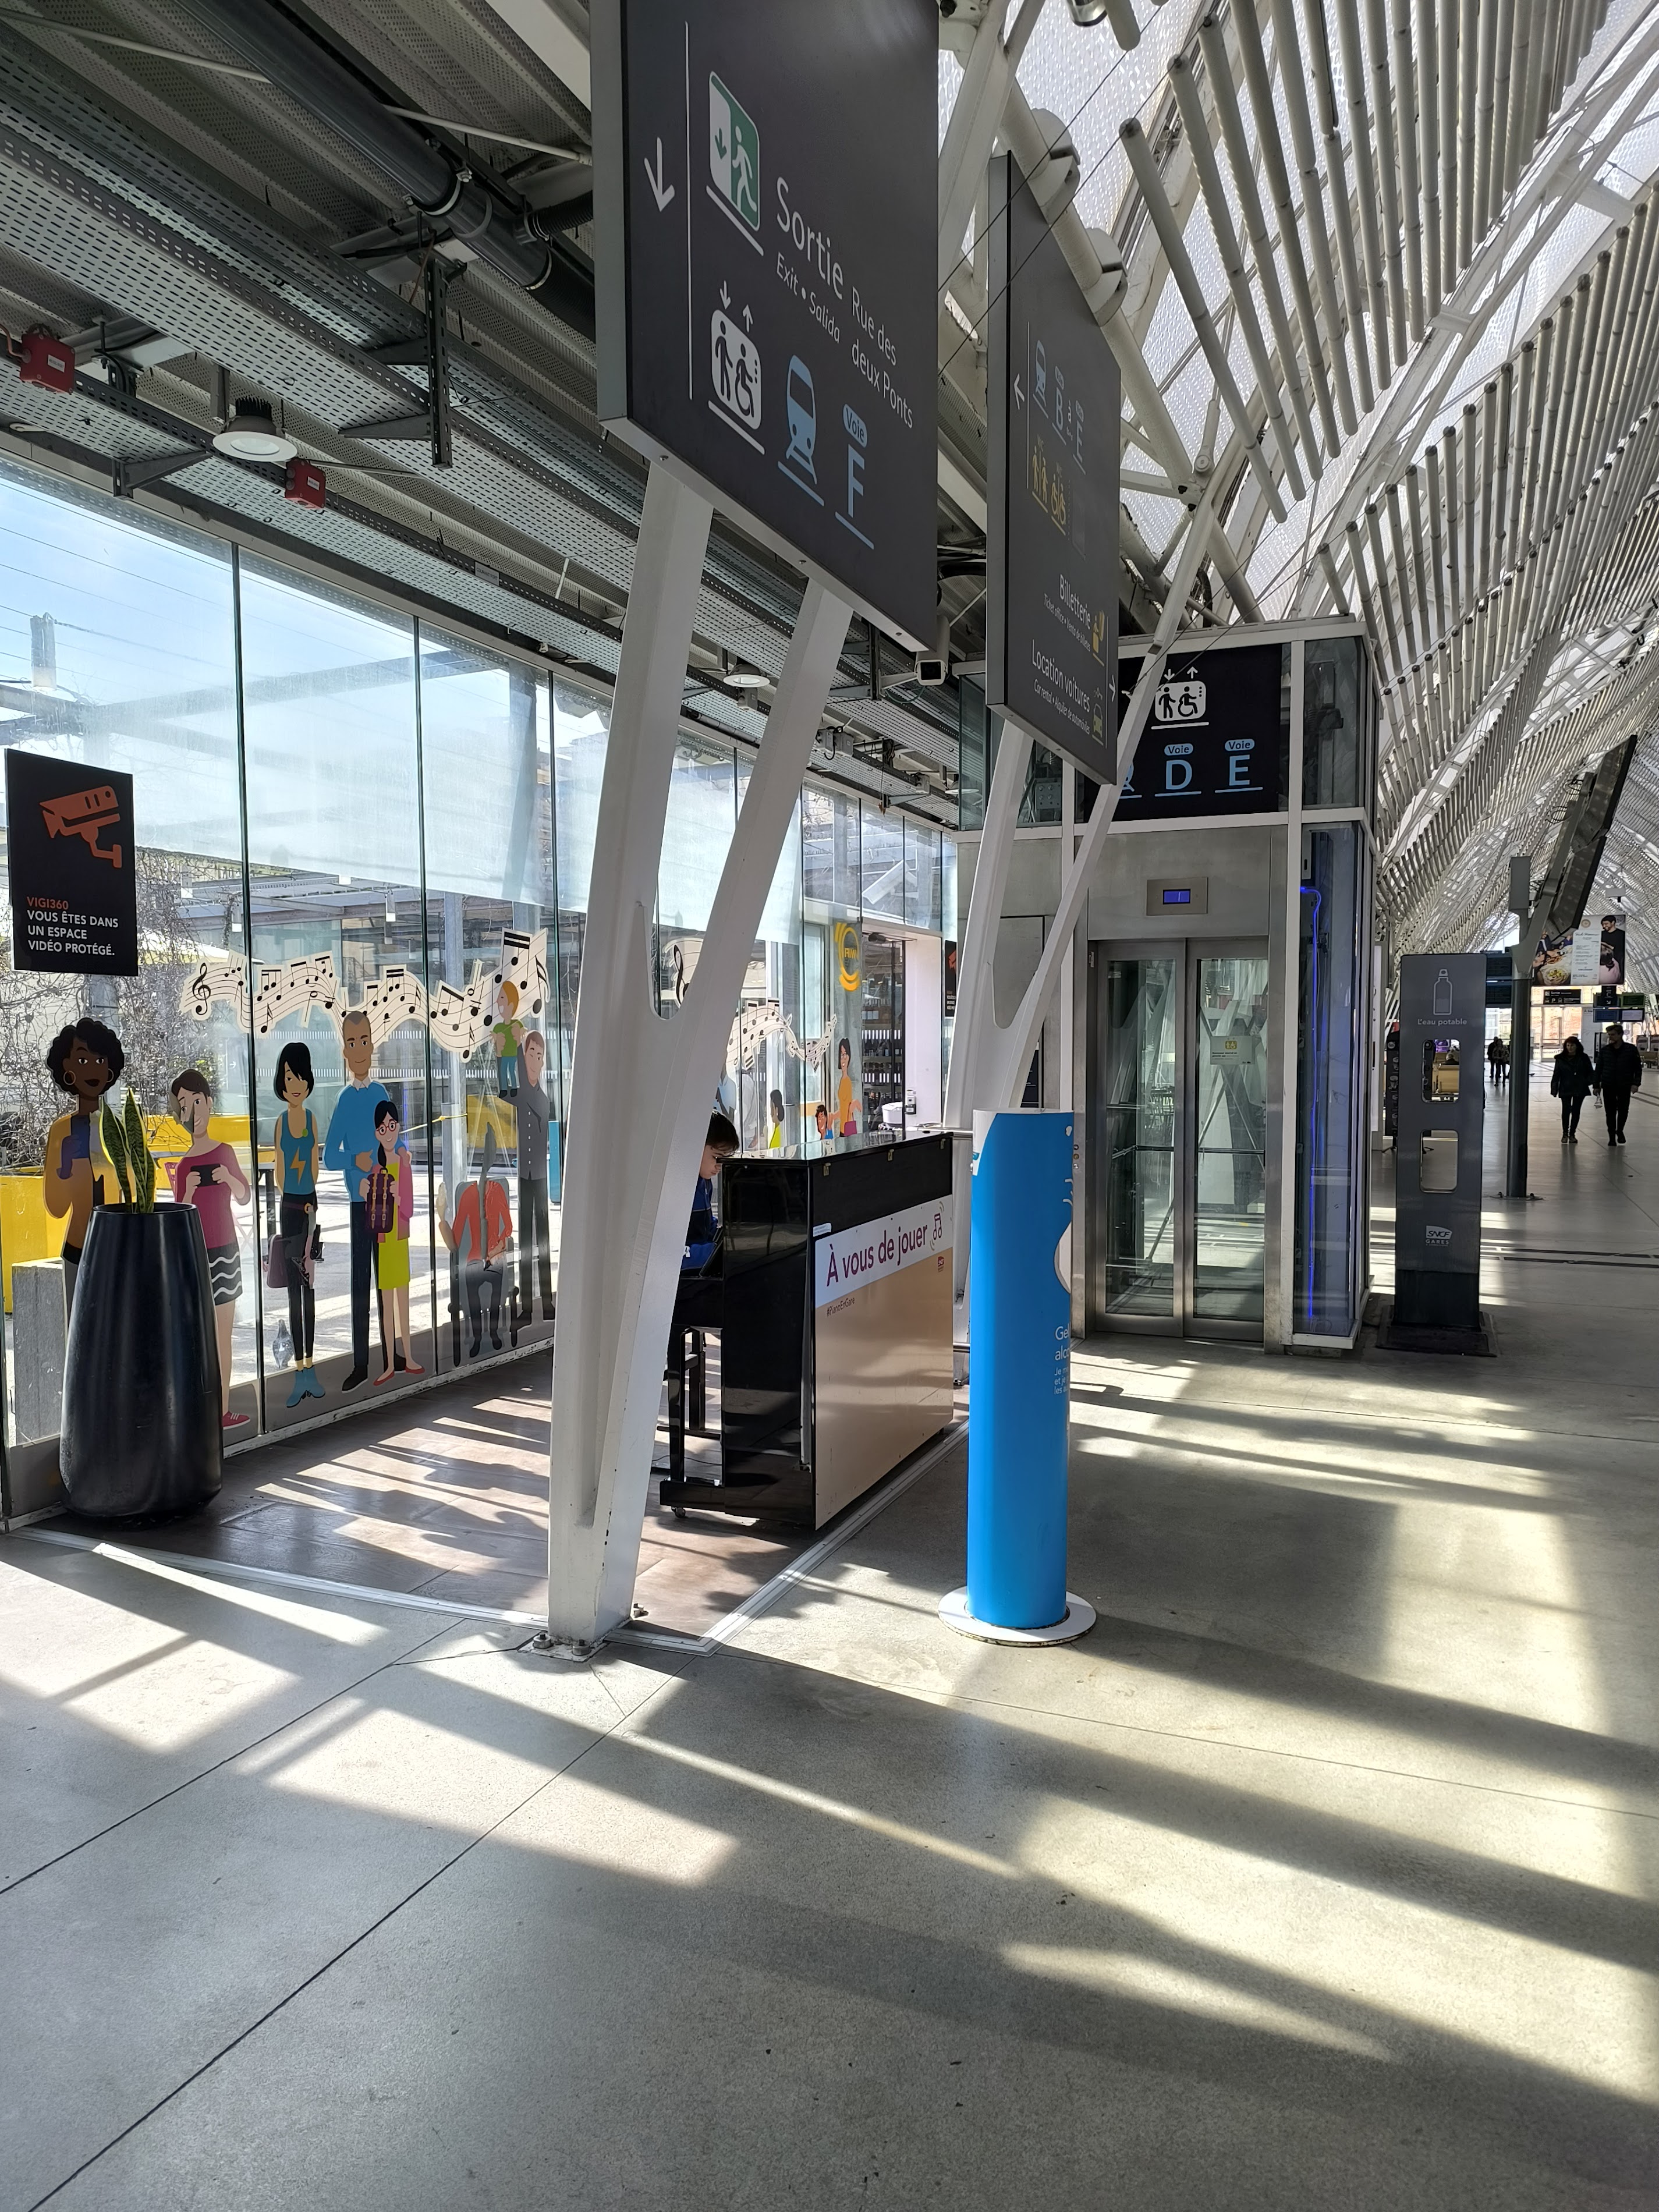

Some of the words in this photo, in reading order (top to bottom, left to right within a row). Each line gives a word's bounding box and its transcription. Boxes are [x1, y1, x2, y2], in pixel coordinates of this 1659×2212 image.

[776, 176, 843, 299] Sortie
[776, 251, 798, 296] Exit
[809, 291, 840, 344] Salida
[852, 286, 875, 339] Rue
[877, 324, 896, 366] des
[852, 339, 881, 392] deux
[882, 375, 913, 429] Ponts
[846, 407, 865, 442] Voie
[1056, 387, 1063, 431] B
[1076, 420, 1083, 463] E
[848, 444, 865, 518] F
[1059, 574, 1091, 630] Billetterie
[1031, 639, 1064, 690] Location
[1065, 673, 1091, 713] voitures
[1168, 745, 1190, 754] Voie
[1228, 739, 1251, 749] Voie
[1165, 759, 1192, 790] D
[1229, 754, 1250, 786] E
[26, 896, 69, 910] VIGI360
[27, 910, 58, 923] VOUS
[61, 911, 86, 925] ÊTES
[90, 916, 119, 928] DANS
[27, 925, 44, 936] UN
[48, 927, 87, 940] ESPACE
[28, 940, 62, 952] VIDÉO
[65, 942, 115, 956] PROTÉGÉ.
[1438, 1018, 1467, 1026] potable
[827, 1243, 839, 1287] À
[842, 1246, 874, 1278] vous
[878, 1229, 894, 1264] de
[897, 1224, 927, 1266] jouer
[827, 1296, 855, 1317] #PianoEnGare
[1054, 1377, 1061, 1385] et
[1054, 1385, 1062, 1395] les
